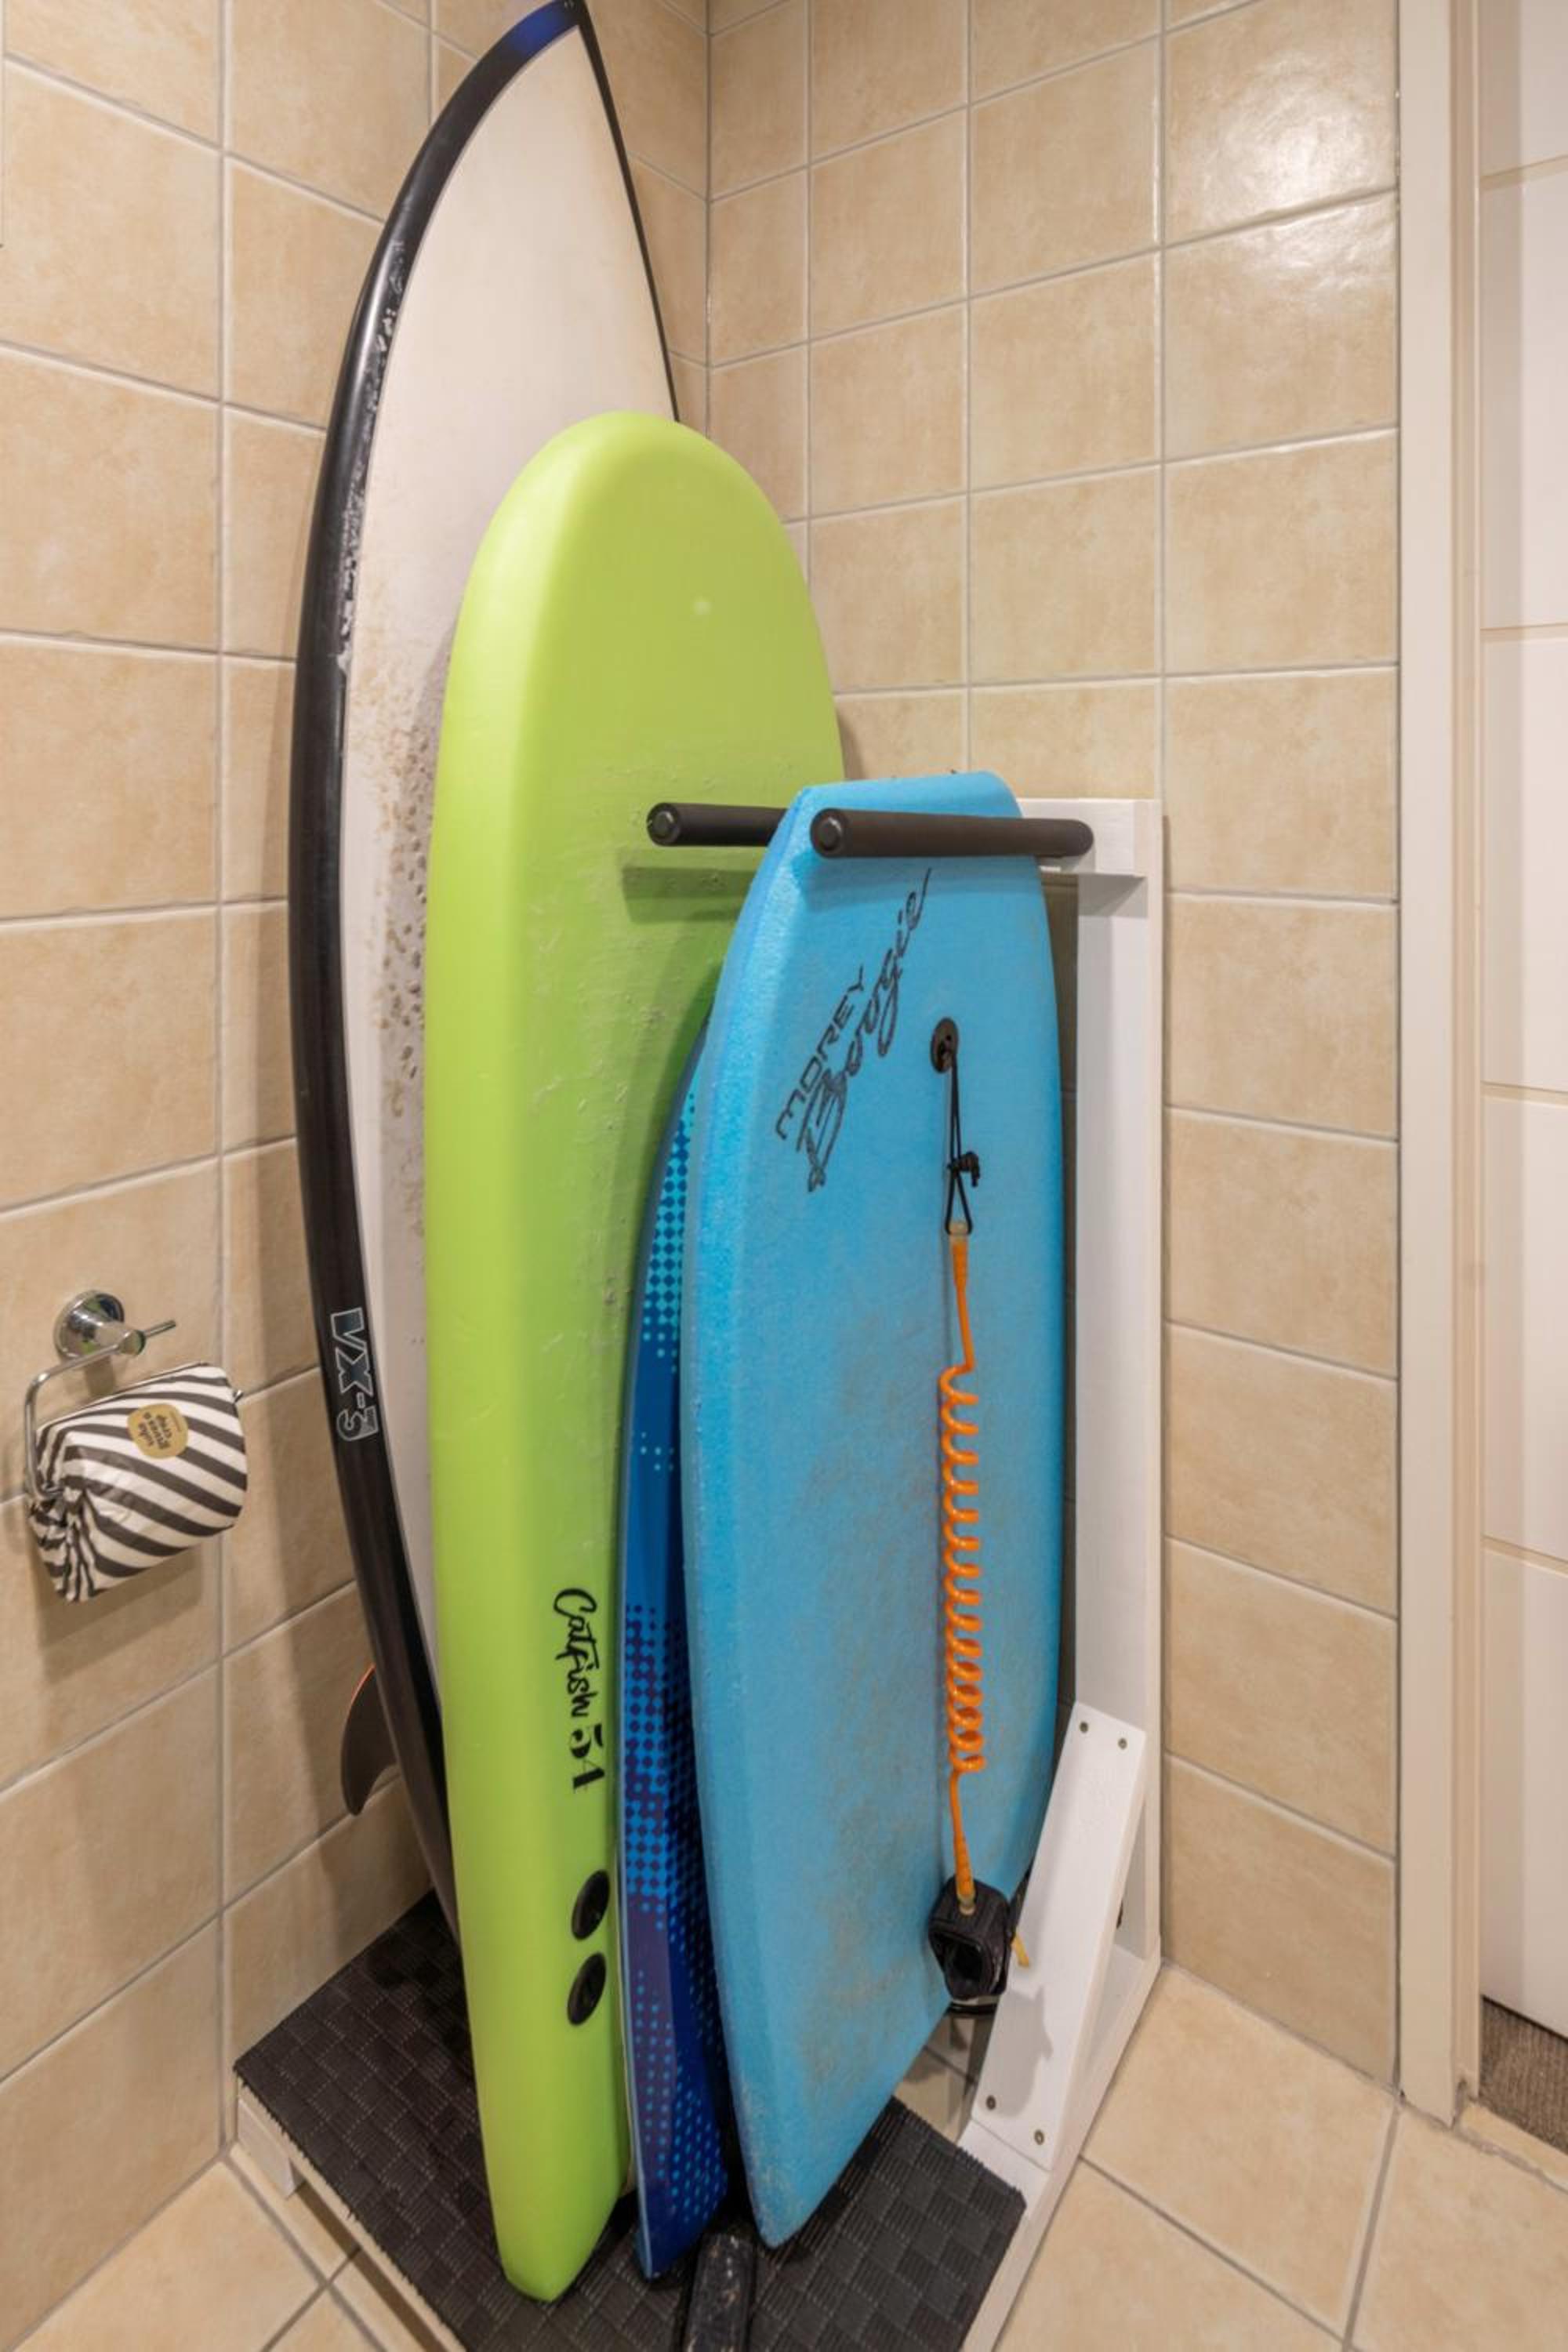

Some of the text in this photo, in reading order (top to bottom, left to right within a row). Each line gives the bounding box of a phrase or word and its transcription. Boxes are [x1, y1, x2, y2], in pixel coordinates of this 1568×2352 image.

[775, 963, 864, 1141] MOREY
[796, 867, 932, 1192] Boogie
[553, 1588, 600, 1718] Catfish
